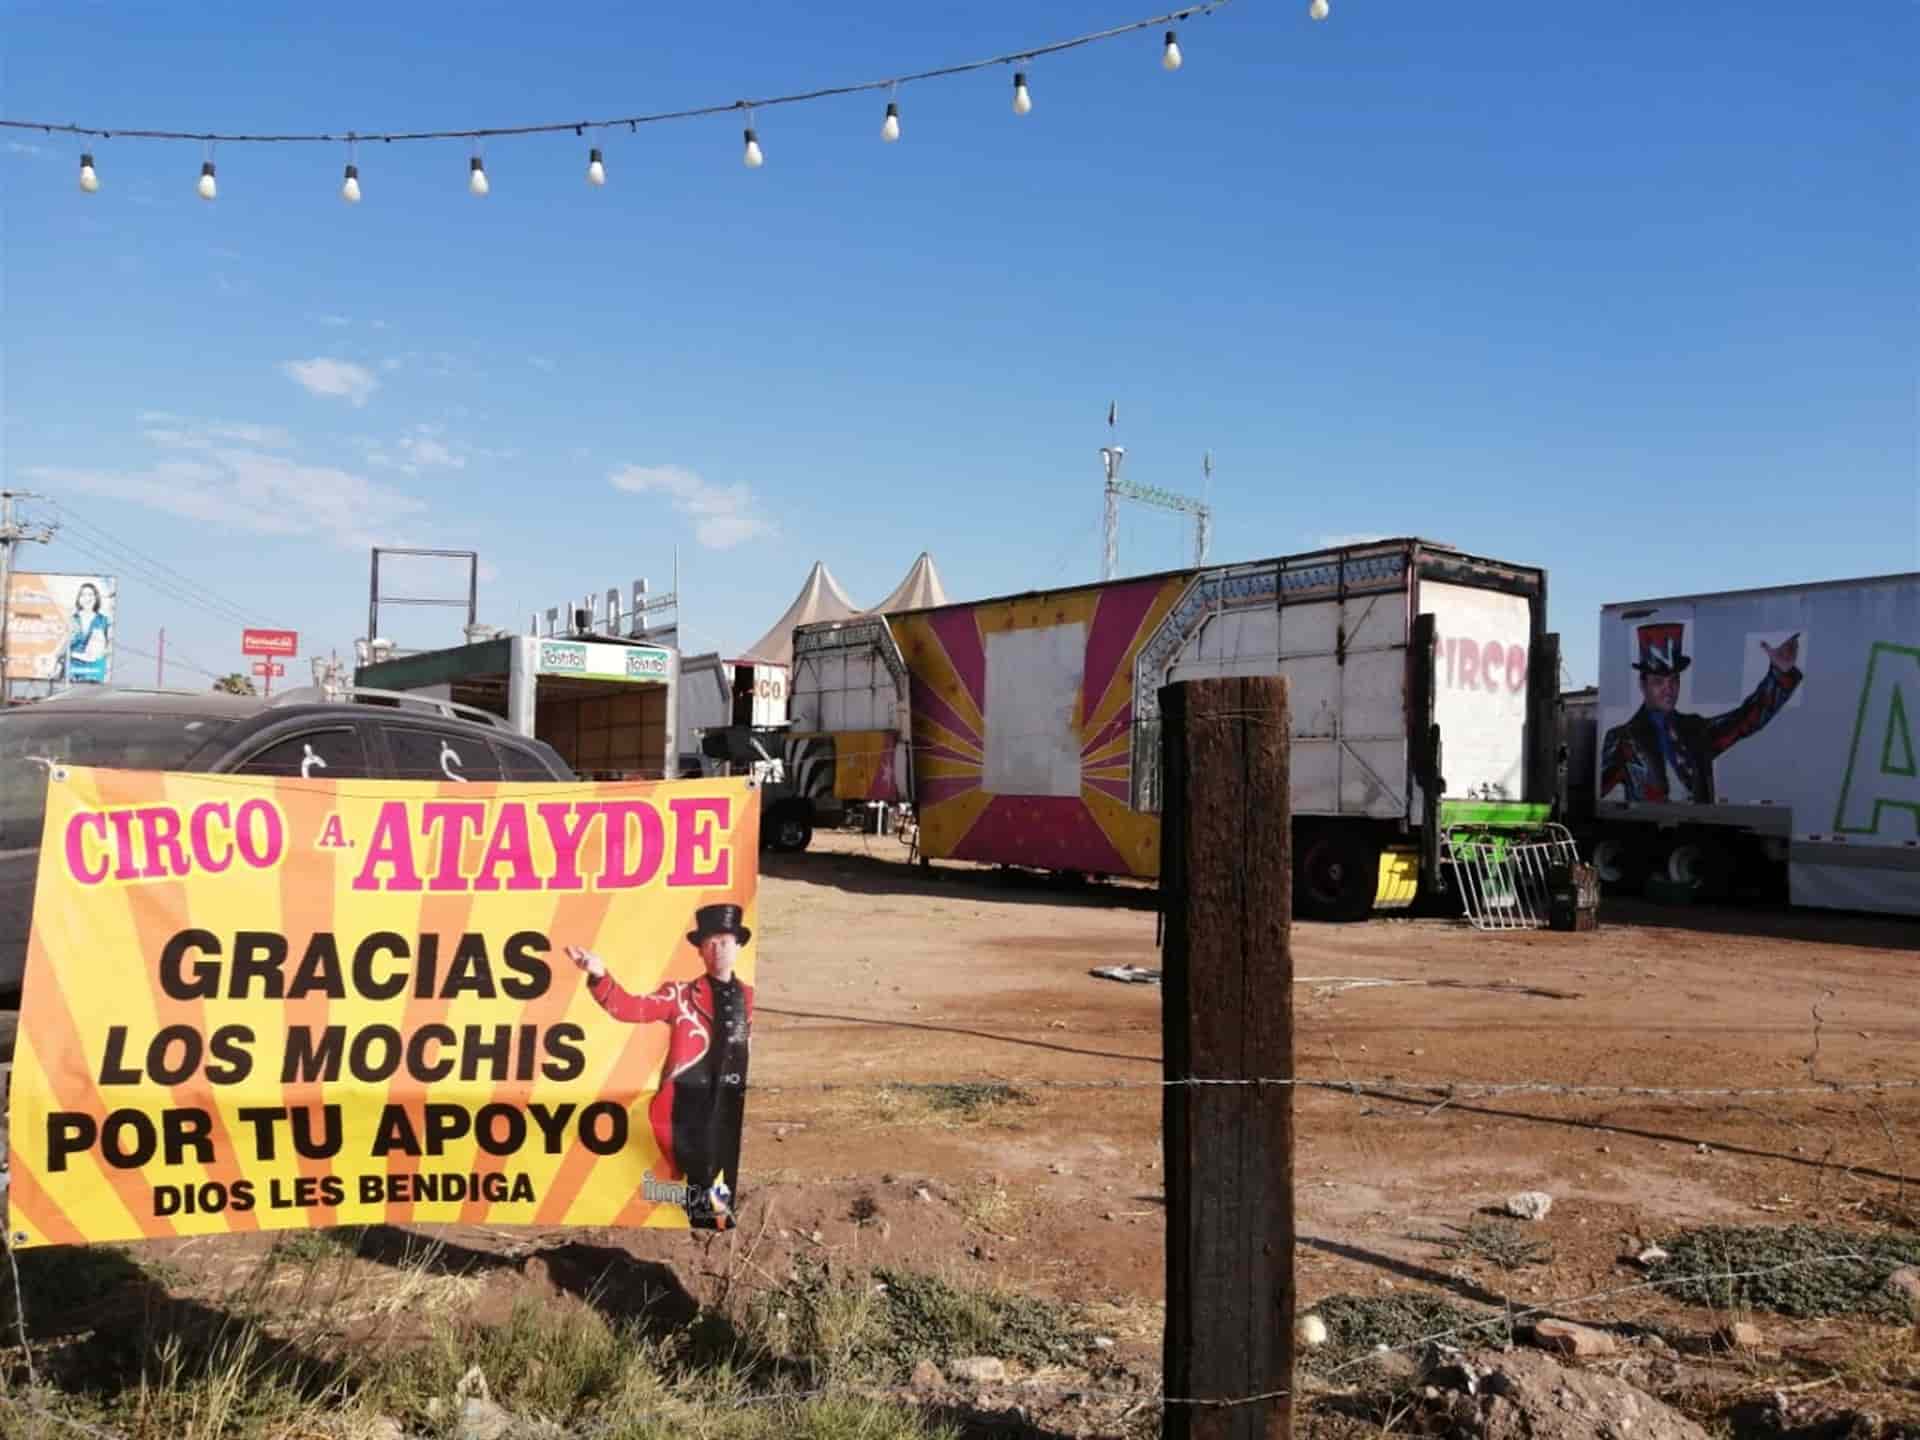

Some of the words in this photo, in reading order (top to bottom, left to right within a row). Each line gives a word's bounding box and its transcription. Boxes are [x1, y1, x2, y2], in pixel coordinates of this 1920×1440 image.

[1433, 636, 1527, 694] IRCO
[65, 798, 284, 885] CIRCO
[318, 814, 356, 848] A.
[351, 797, 731, 891] ATAYDE
[160, 929, 553, 1001] GRACIAS
[99, 1025, 256, 1086] LOS
[281, 1023, 585, 1083] MOCHIS
[47, 1107, 215, 1172] POR
[238, 1103, 343, 1161] TU
[371, 1101, 629, 1157] APOYO
[154, 1180, 255, 1217] DIOS
[270, 1176, 345, 1209] LES
[359, 1172, 535, 1204] BENDIGA
